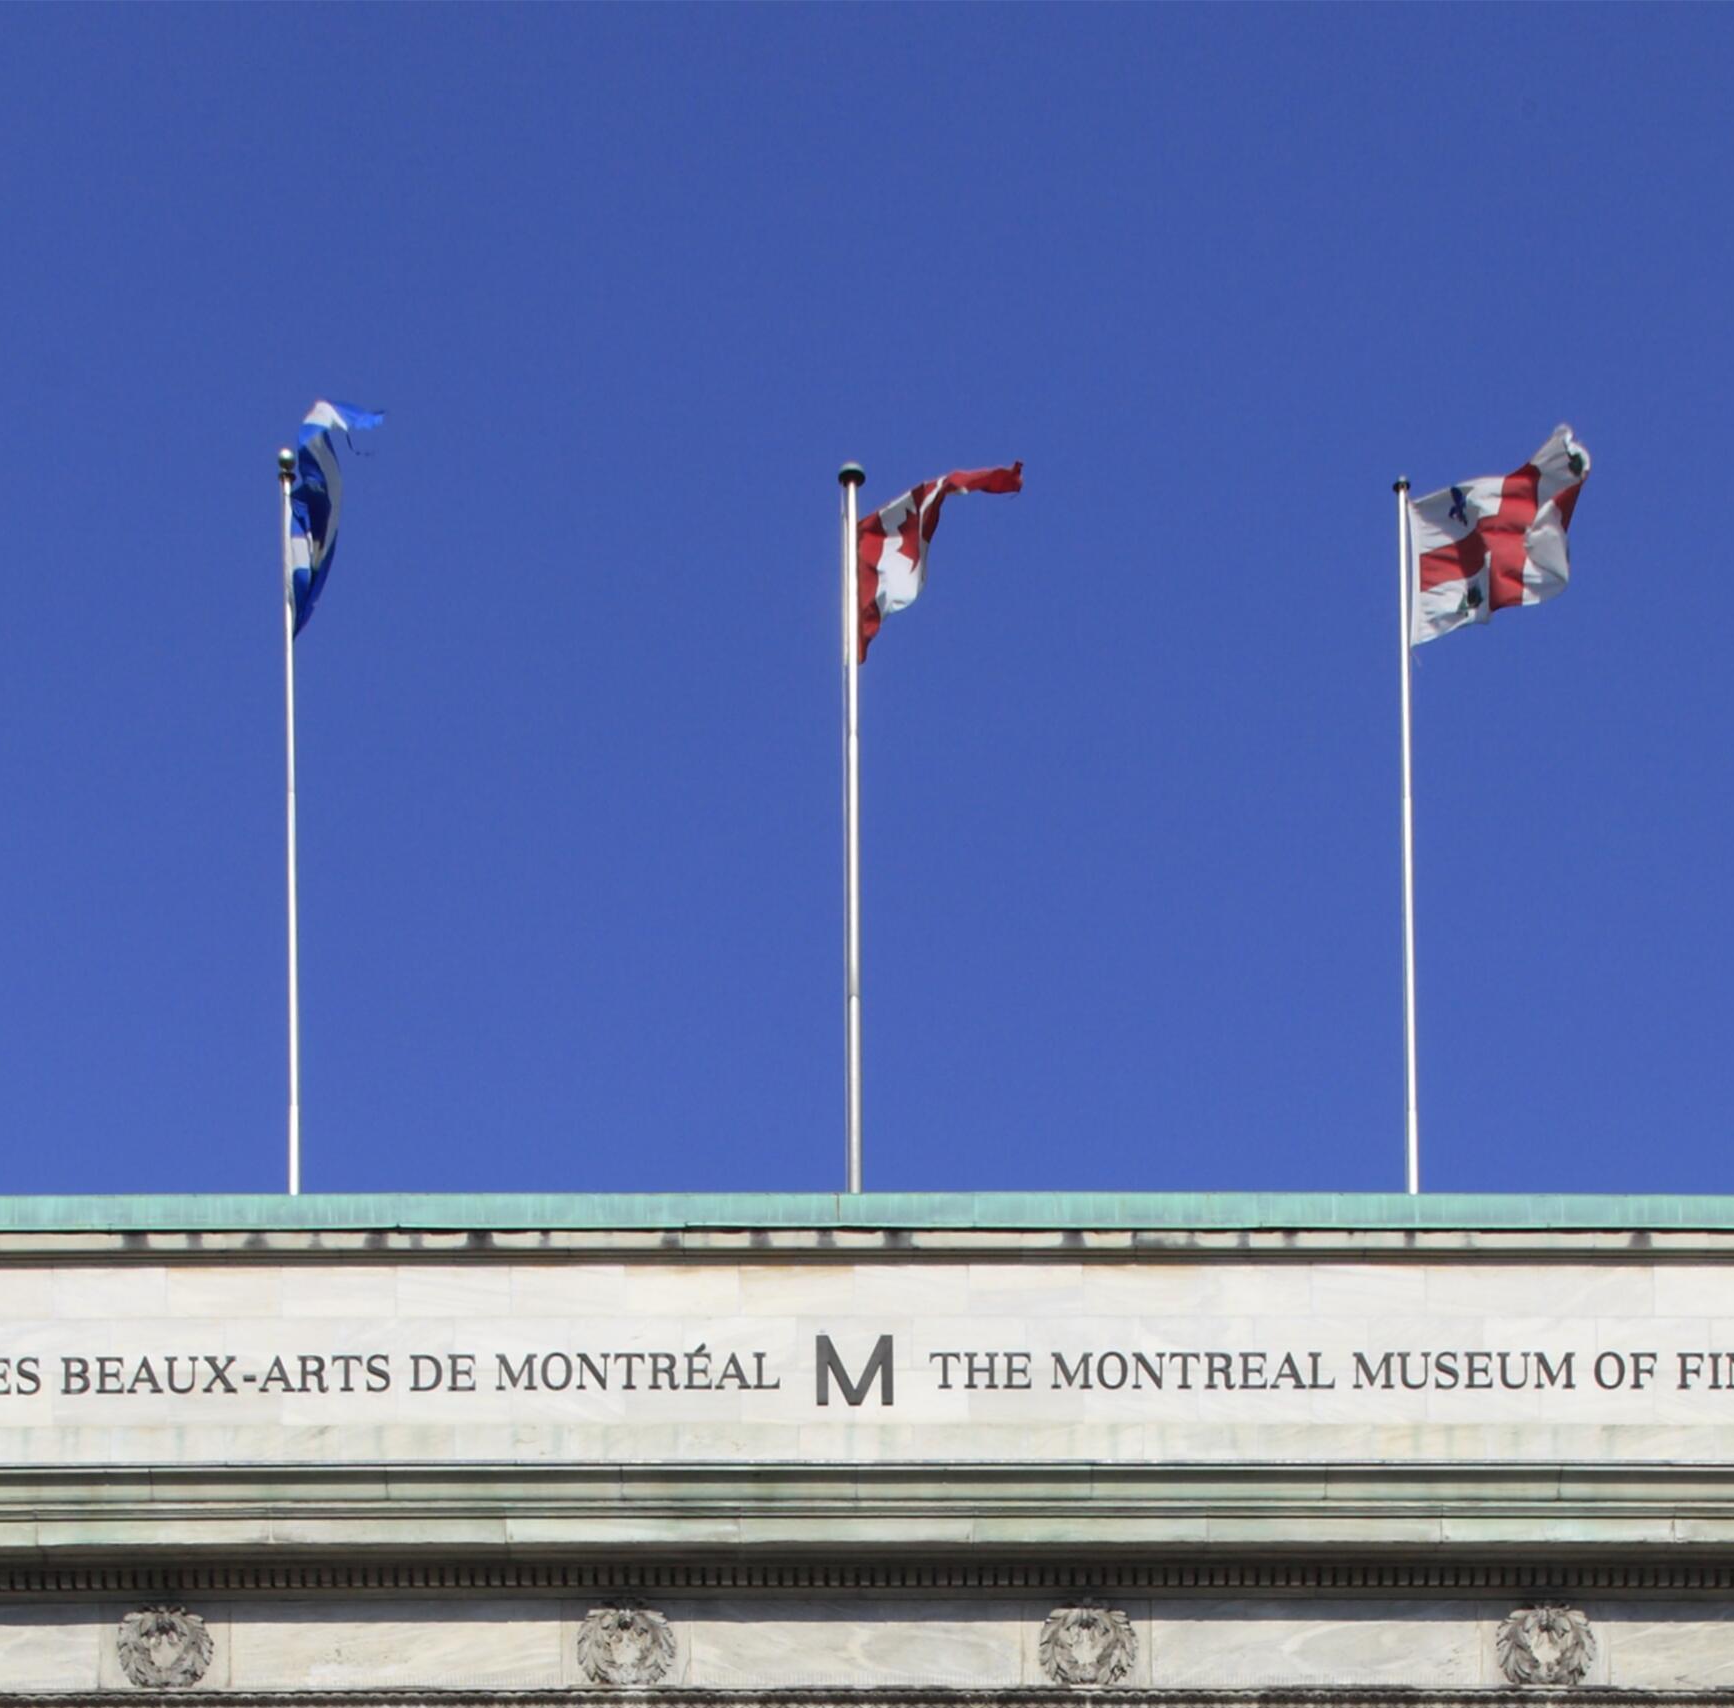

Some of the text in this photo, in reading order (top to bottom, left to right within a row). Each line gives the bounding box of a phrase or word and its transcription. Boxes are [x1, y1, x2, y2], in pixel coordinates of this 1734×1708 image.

[60, 1353, 392, 1396] BEAUX-ARTS
[409, 1353, 477, 1393] DE
[494, 1342, 781, 1392] MONTRÉAL
[816, 1333, 895, 1407] M
[928, 1351, 1033, 1390] THE
[1050, 1350, 1336, 1391] MONTREAL
[1351, 1350, 1577, 1391] MUSEUM
[1593, 1351, 1658, 1391] OF
